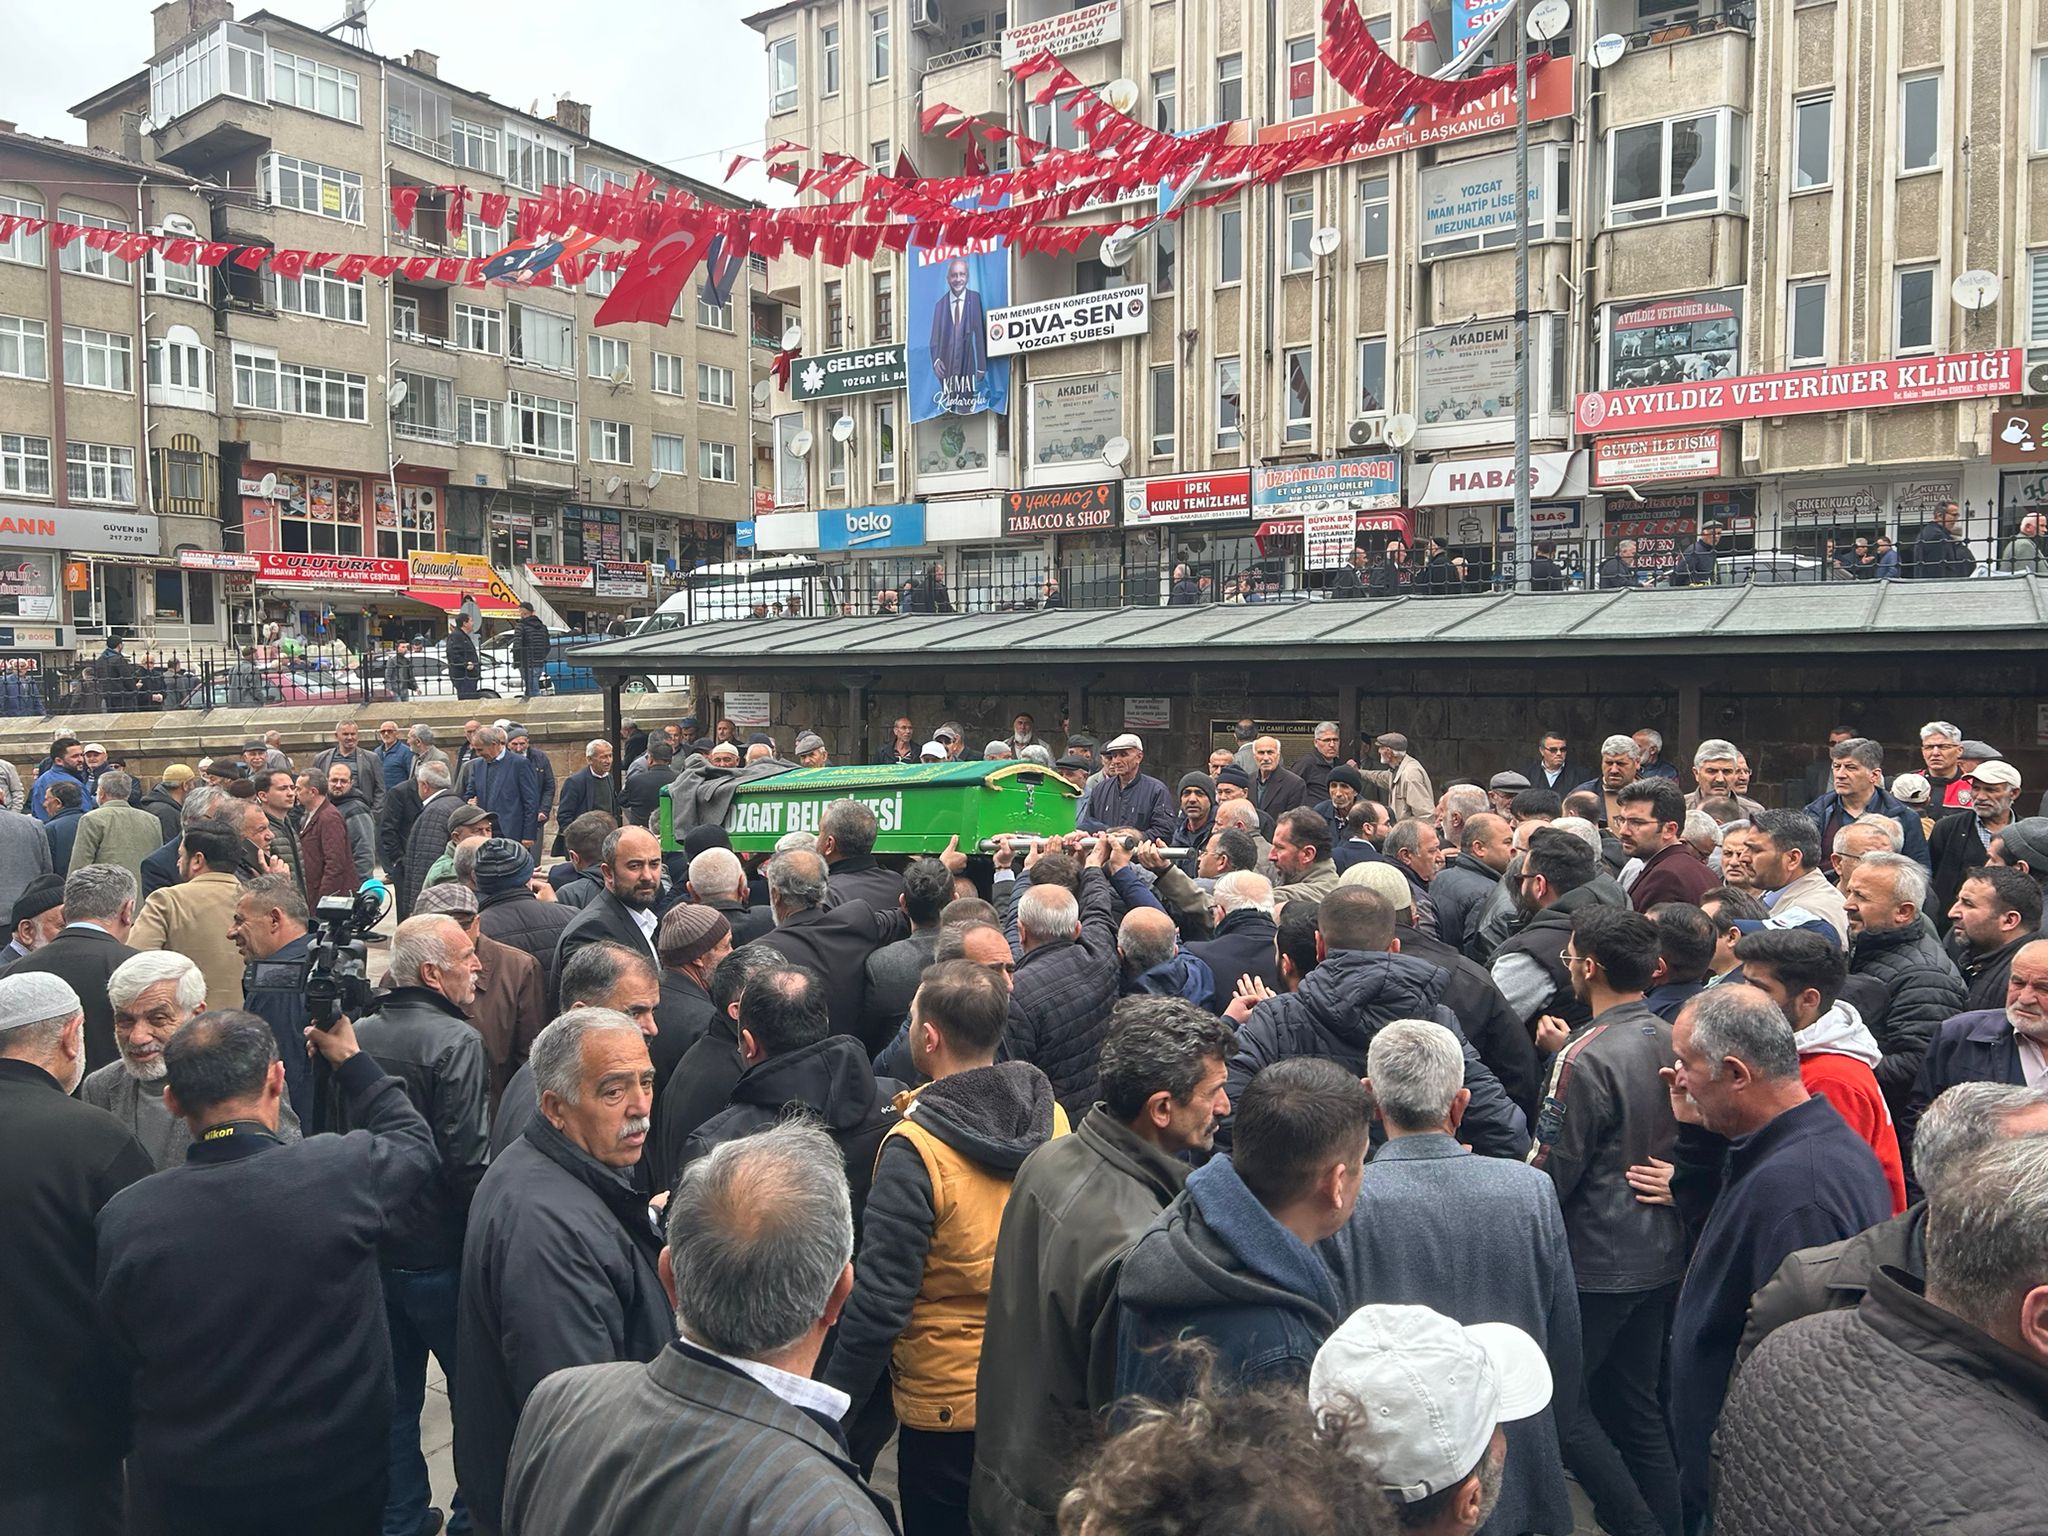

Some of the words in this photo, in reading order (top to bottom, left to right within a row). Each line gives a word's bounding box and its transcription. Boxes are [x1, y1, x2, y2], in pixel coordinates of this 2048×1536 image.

[1006, 20, 1054, 41] YOZGAT
[1057, 2, 1118, 27] BELEDİYE
[1016, 27, 1066, 48] BAŞKAN
[1068, 17, 1106, 34] ADAYI
[1049, 28, 1104, 50] KORKMAZ
[1420, 113, 1505, 141] BAŞKANLIĞI
[1135, 187, 1147, 198] 35
[1147, 185, 1158, 196] 59
[1461, 179, 1504, 198] YOZGAT
[1427, 204, 1455, 221] İMAM
[1457, 197, 1489, 215] HATİP
[1491, 186, 1539, 209] LİSERİ
[1434, 214, 1496, 236] MEZUNLARI
[989, 311, 1008, 323] TÜM
[1009, 302, 1061, 320] MEMUR-SEN
[1062, 287, 1145, 310] KONFEDERASYONU
[1617, 309, 1656, 325] AYYILDIZ
[1657, 302, 1703, 320] VETERİNER
[1017, 333, 1067, 350] YOZGAT
[1069, 323, 1115, 342] ŞUBESİ
[1449, 324, 1509, 347] AKADEMİ
[826, 349, 899, 374] GELECEK
[842, 375, 877, 388] YOZGAT
[880, 372, 890, 383] İL
[1057, 381, 1099, 398] AKADEMİ
[1607, 386, 1724, 418] AYYILDIZ
[1731, 368, 1889, 406] VETERİNER
[1897, 350, 2011, 389] KLİNİĞİ
[1601, 440, 1649, 457] GÜVEN
[1652, 433, 1716, 452] İLETİŞİM
[1257, 465, 1337, 494] DÜZCANLAR
[1339, 460, 1395, 483] KASABI
[1449, 466, 1540, 491] HABAŞ
[1184, 480, 1211, 495] İPEK
[1277, 487, 1288, 496] ET
[1305, 482, 1324, 494] SÜT
[1326, 479, 1374, 492] ÜRÜNLERİ
[1920, 484, 1953, 493] KUTAY
[1922, 493, 1953, 502] HİLAL
[1025, 489, 1094, 514] YAKAMOZ
[1151, 499, 1180, 513] KURU
[1183, 493, 1248, 510] TEMİZLEME
[1796, 498, 1828, 511] ERKEK
[1829, 491, 1871, 509] KUAFÖR
[103, 523, 135, 533] GÜVEN
[846, 511, 893, 533] beko
[1008, 513, 1063, 531] TABACCO
[1065, 512, 1076, 527] &
[1077, 509, 1112, 527] SHOP
[1308, 514, 1336, 525] BÜYÜK
[1337, 514, 1354, 523] BAŞ
[1311, 523, 1350, 532] KURBANLIK
[1357, 520, 1394, 531] ASABI
[737, 527, 753, 535] beko
[1308, 530, 1354, 539] SATIŞLARIMIZ
[1637, 537, 1675, 552] ÜVEN
[287, 556, 377, 571] ULUTÜRK
[411, 558, 464, 581] Çapanoğlu
[263, 567, 297, 577] HIRDAVAT
[301, 568, 340, 580] ZÜCCACİYE
[342, 569, 370, 580] PLASTİK
[370, 571, 401, 583] ÇEŞİTLERİ
[28, 633, 55, 641] BOSCH
[726, 801, 783, 834] OZGAT
[204, 1127, 235, 1141] Nikon
